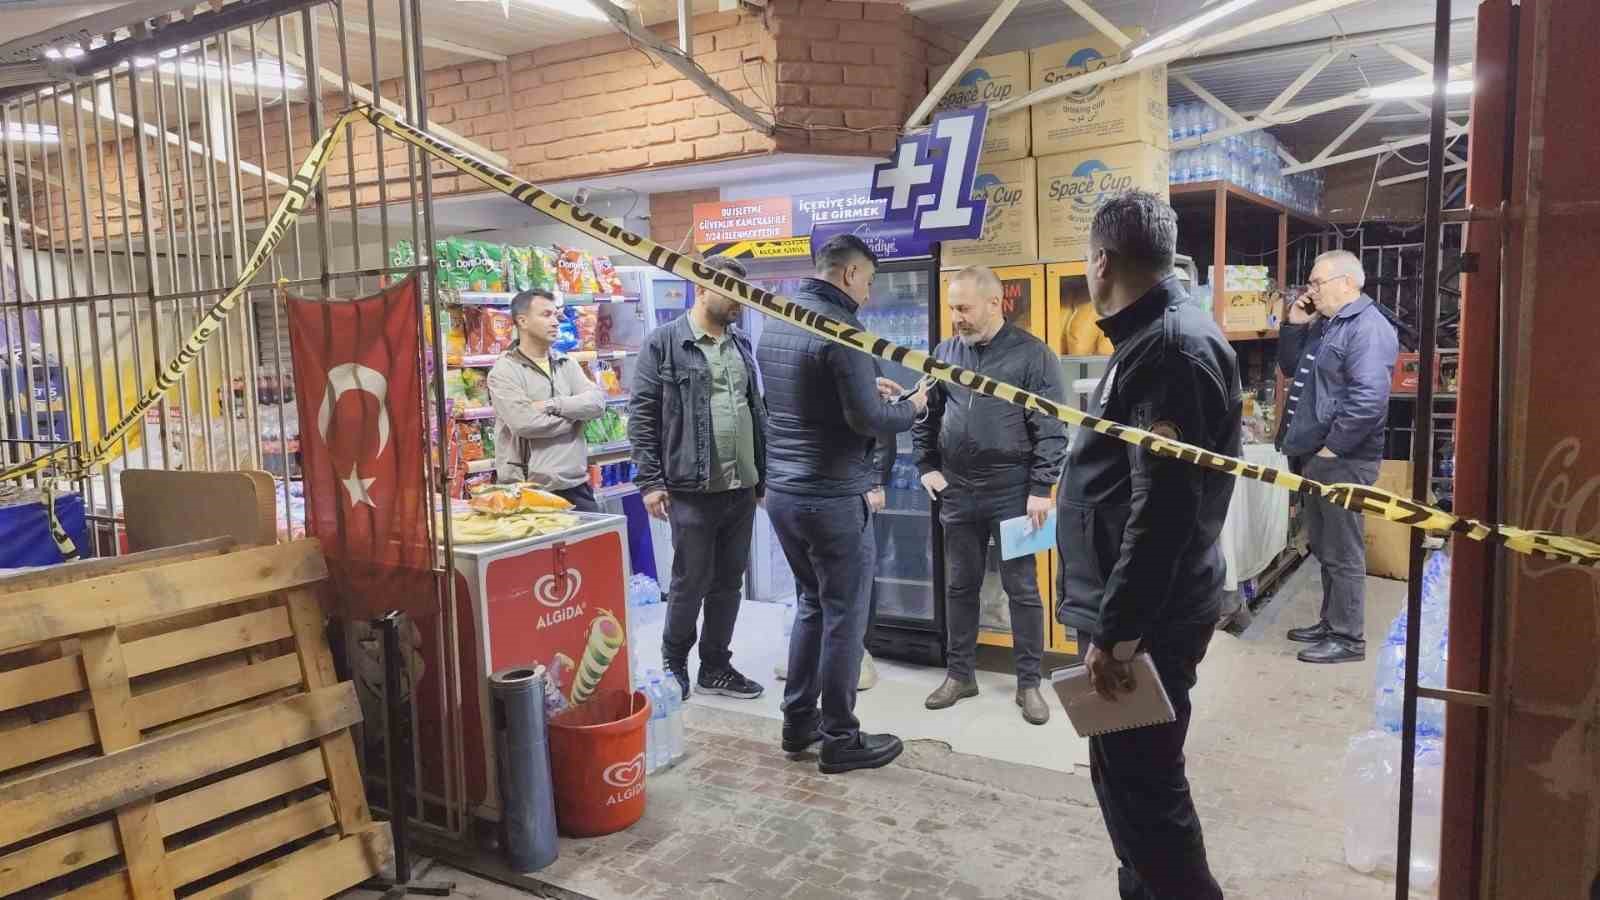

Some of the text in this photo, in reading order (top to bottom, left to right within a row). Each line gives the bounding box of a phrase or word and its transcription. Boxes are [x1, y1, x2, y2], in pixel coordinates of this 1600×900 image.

[984, 81, 1012, 101] Cup
[877, 115, 975, 229] +1
[1049, 172, 1131, 199] Space Cup
[993, 186, 1022, 206] Cup
[831, 206, 879, 220] GİRMEK
